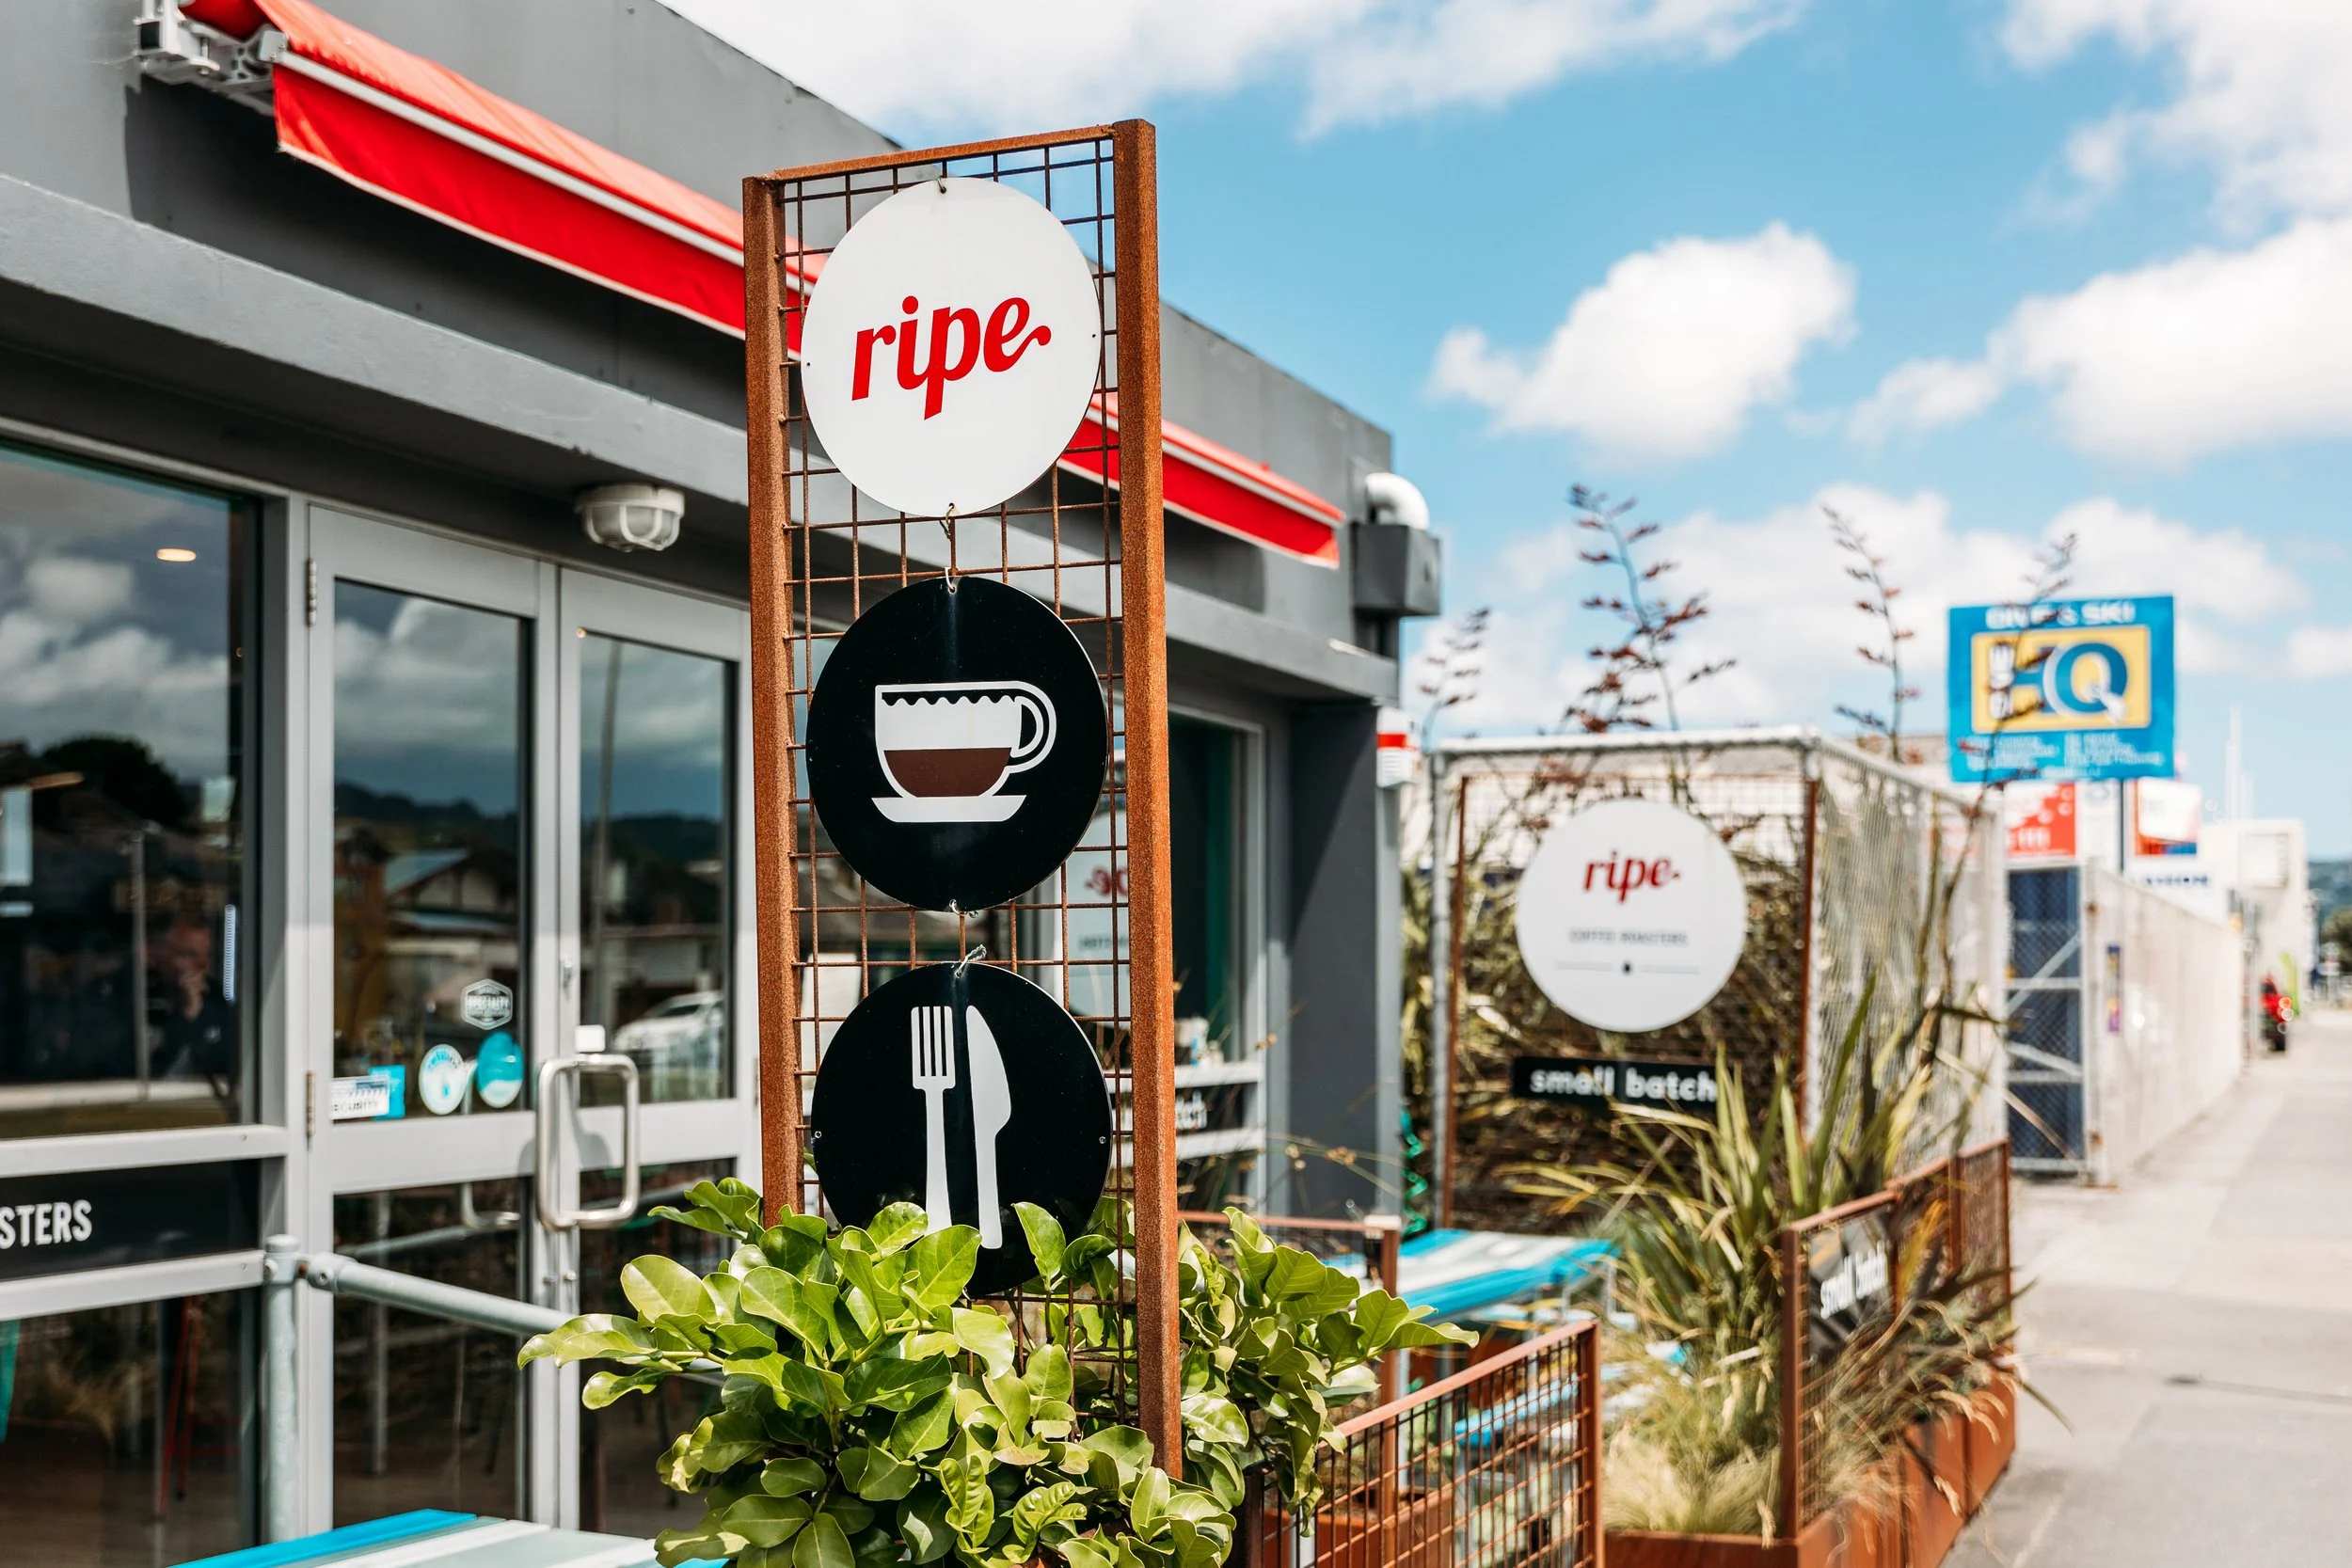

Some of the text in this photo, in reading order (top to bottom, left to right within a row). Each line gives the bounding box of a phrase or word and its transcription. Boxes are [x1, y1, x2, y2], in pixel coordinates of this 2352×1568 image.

[851, 295, 1052, 420] ripe
[1582, 850, 1681, 904] ripe
[1530, 1066, 1719, 1101] small batch
